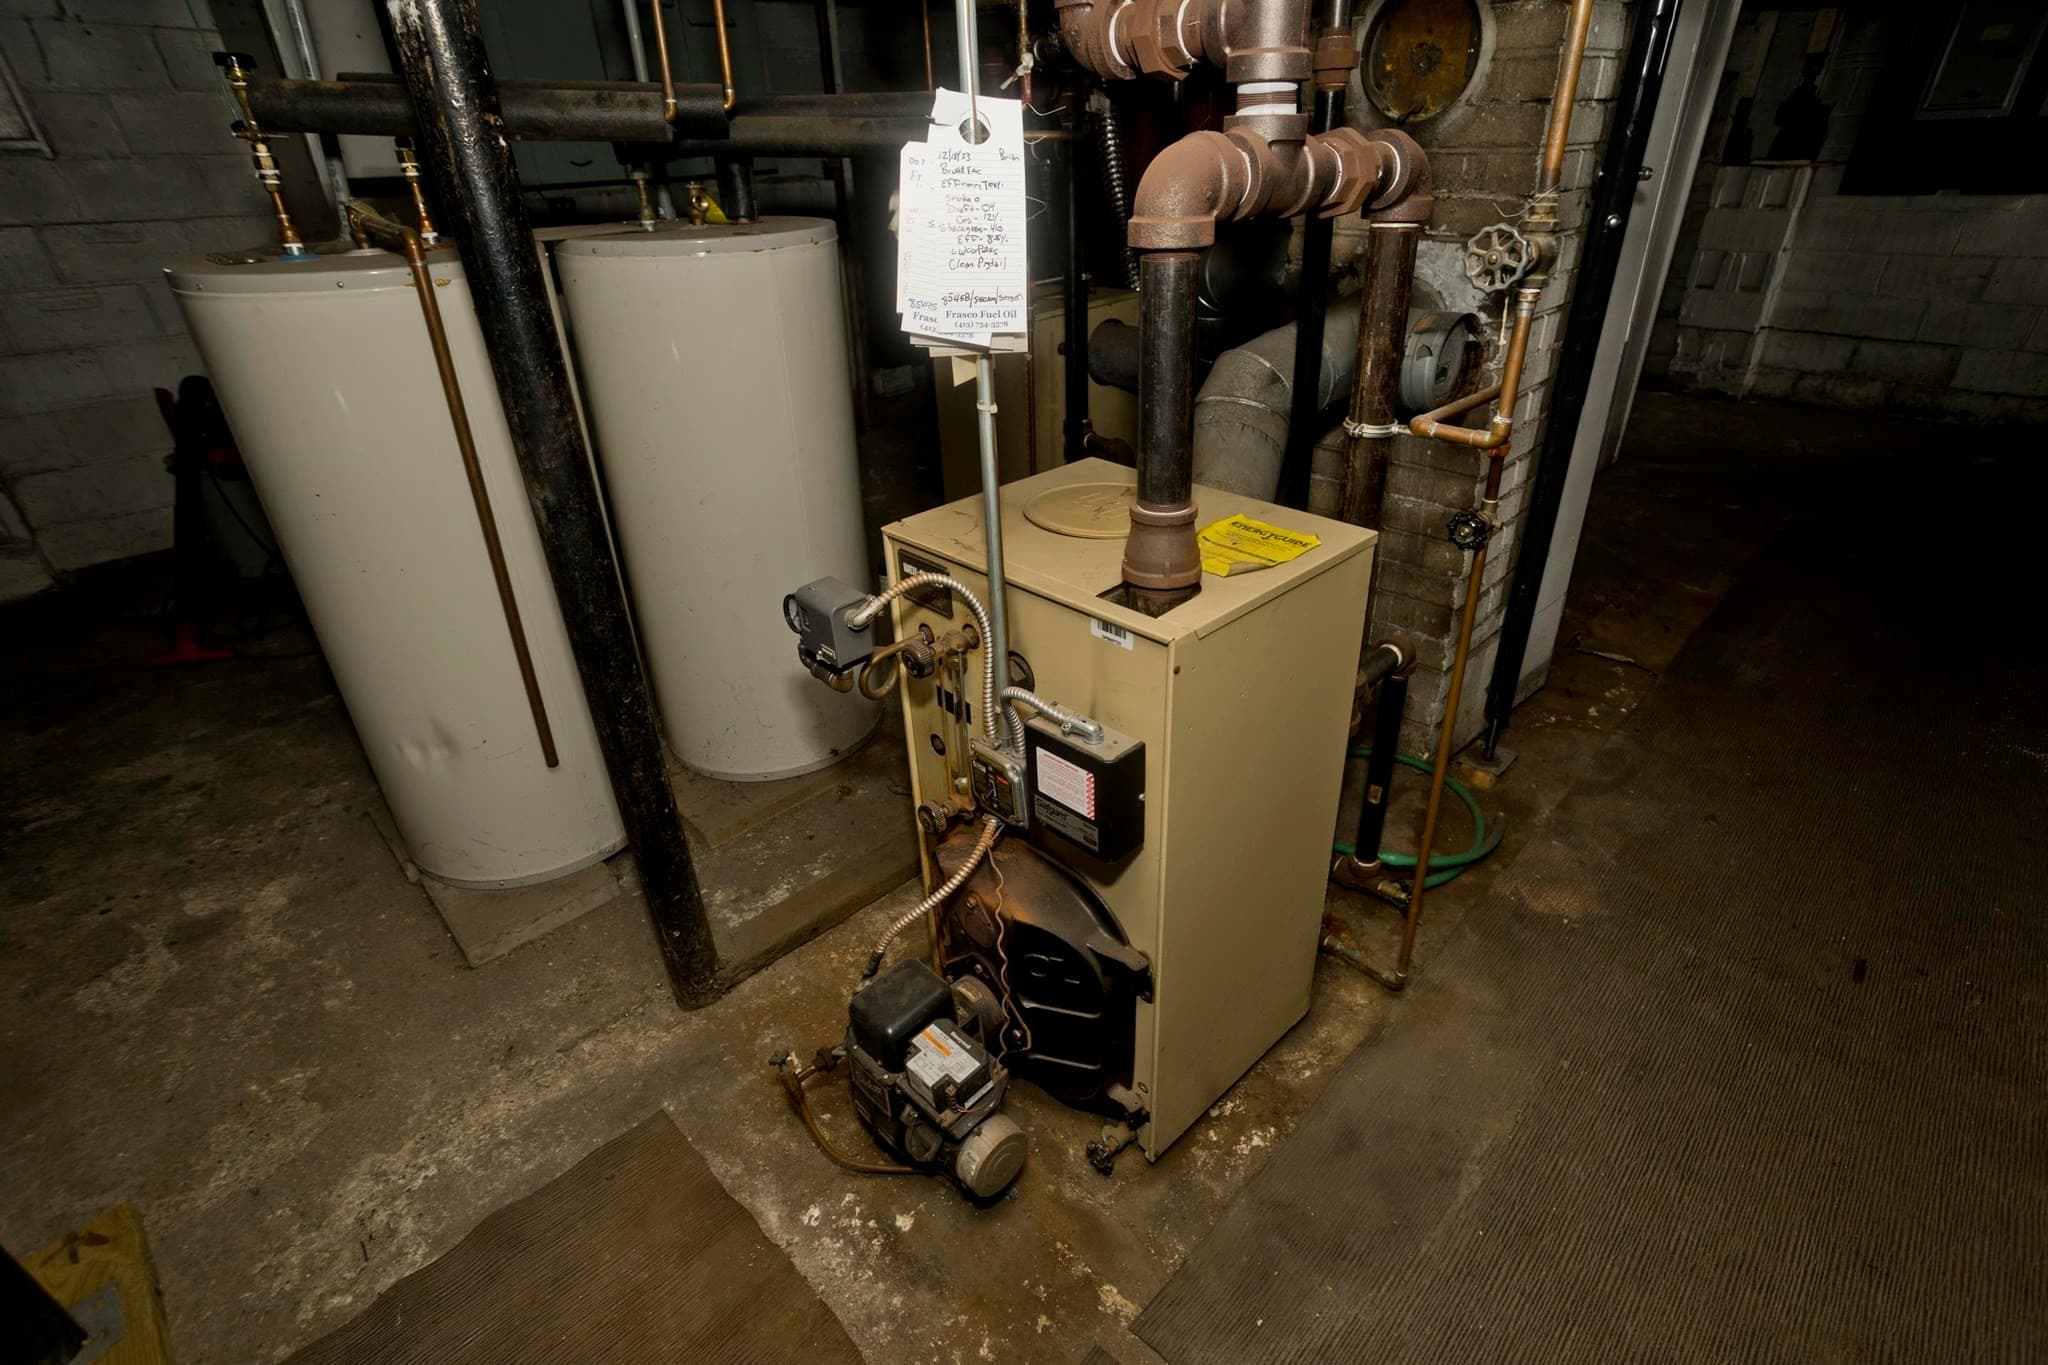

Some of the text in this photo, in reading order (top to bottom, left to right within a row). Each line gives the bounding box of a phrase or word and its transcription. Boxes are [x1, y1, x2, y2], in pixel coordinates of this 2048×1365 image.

[945, 309, 1017, 319] Frasco Fuel Oil
